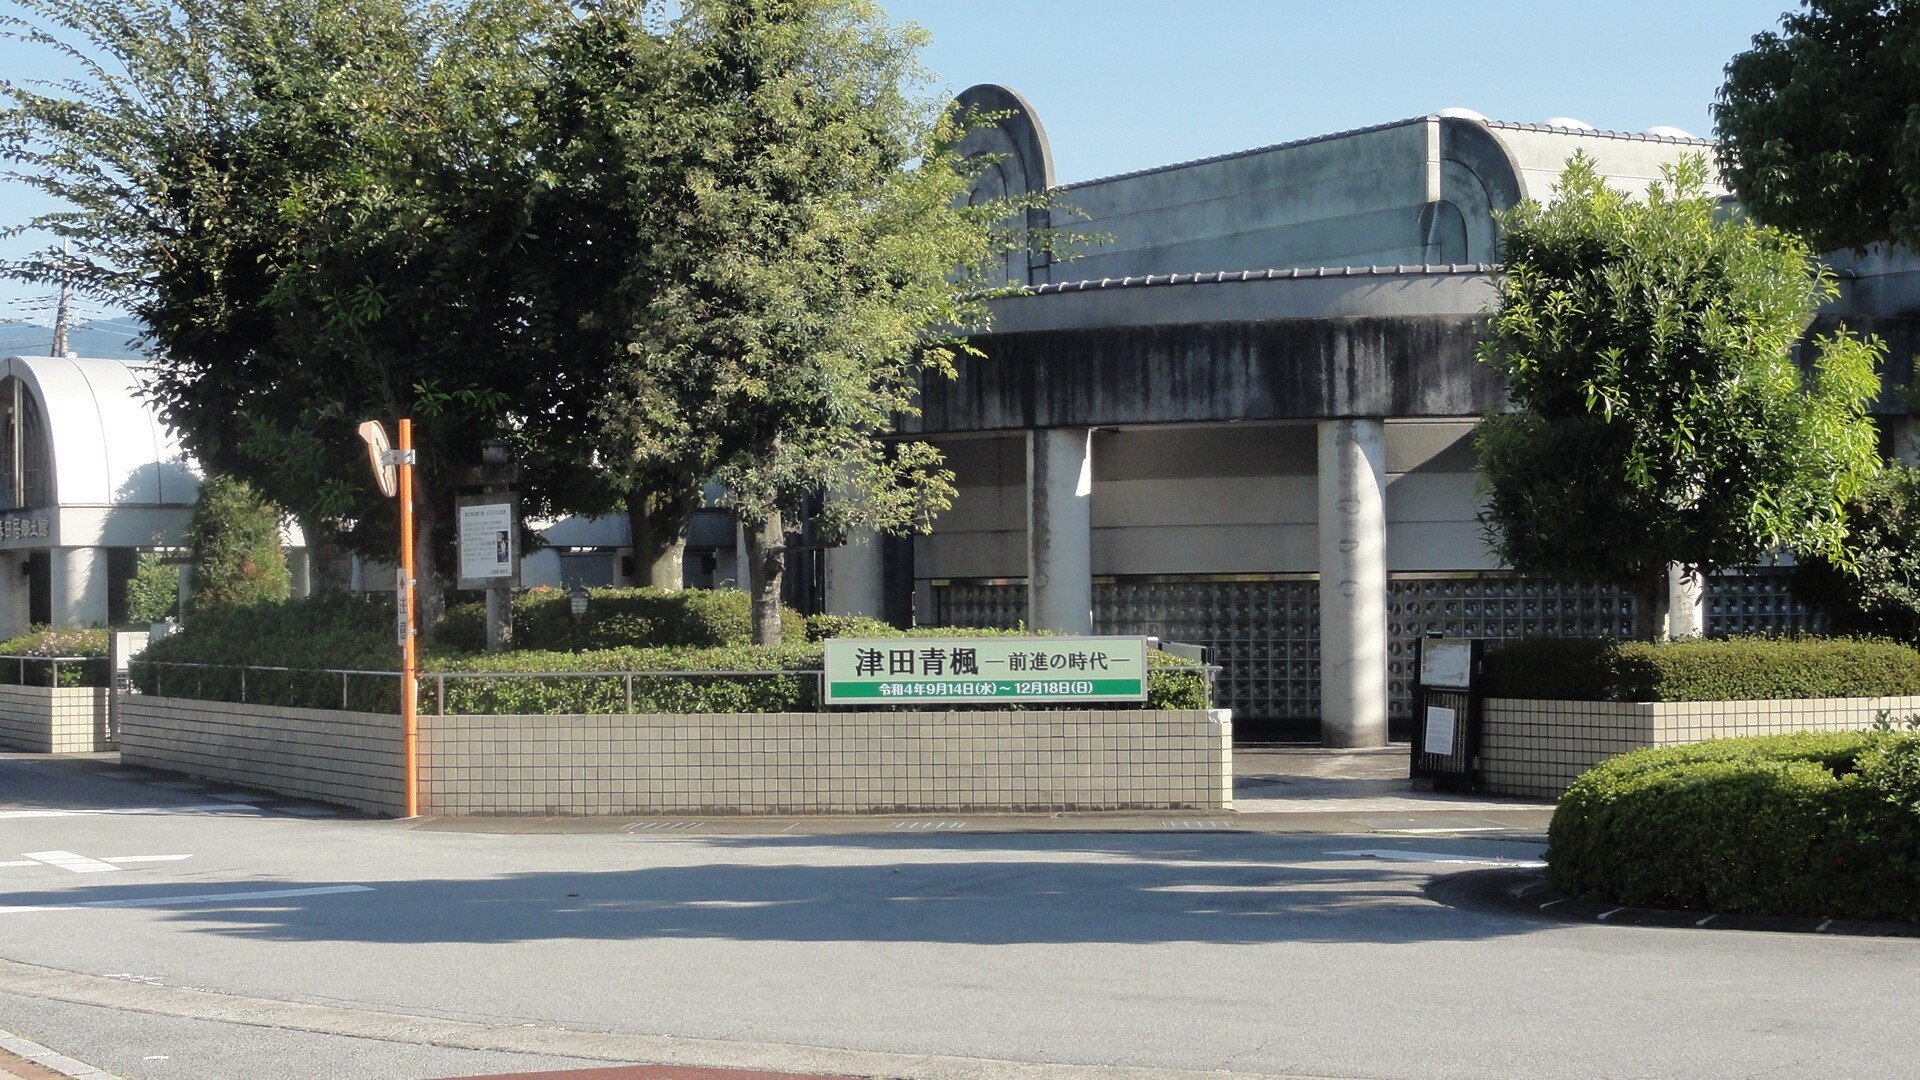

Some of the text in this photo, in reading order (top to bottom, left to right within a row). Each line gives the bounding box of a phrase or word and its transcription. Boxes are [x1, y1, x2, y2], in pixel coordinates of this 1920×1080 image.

[399, 596, 408, 639] 注意
[854, 647, 979, 677] 津田青楓
